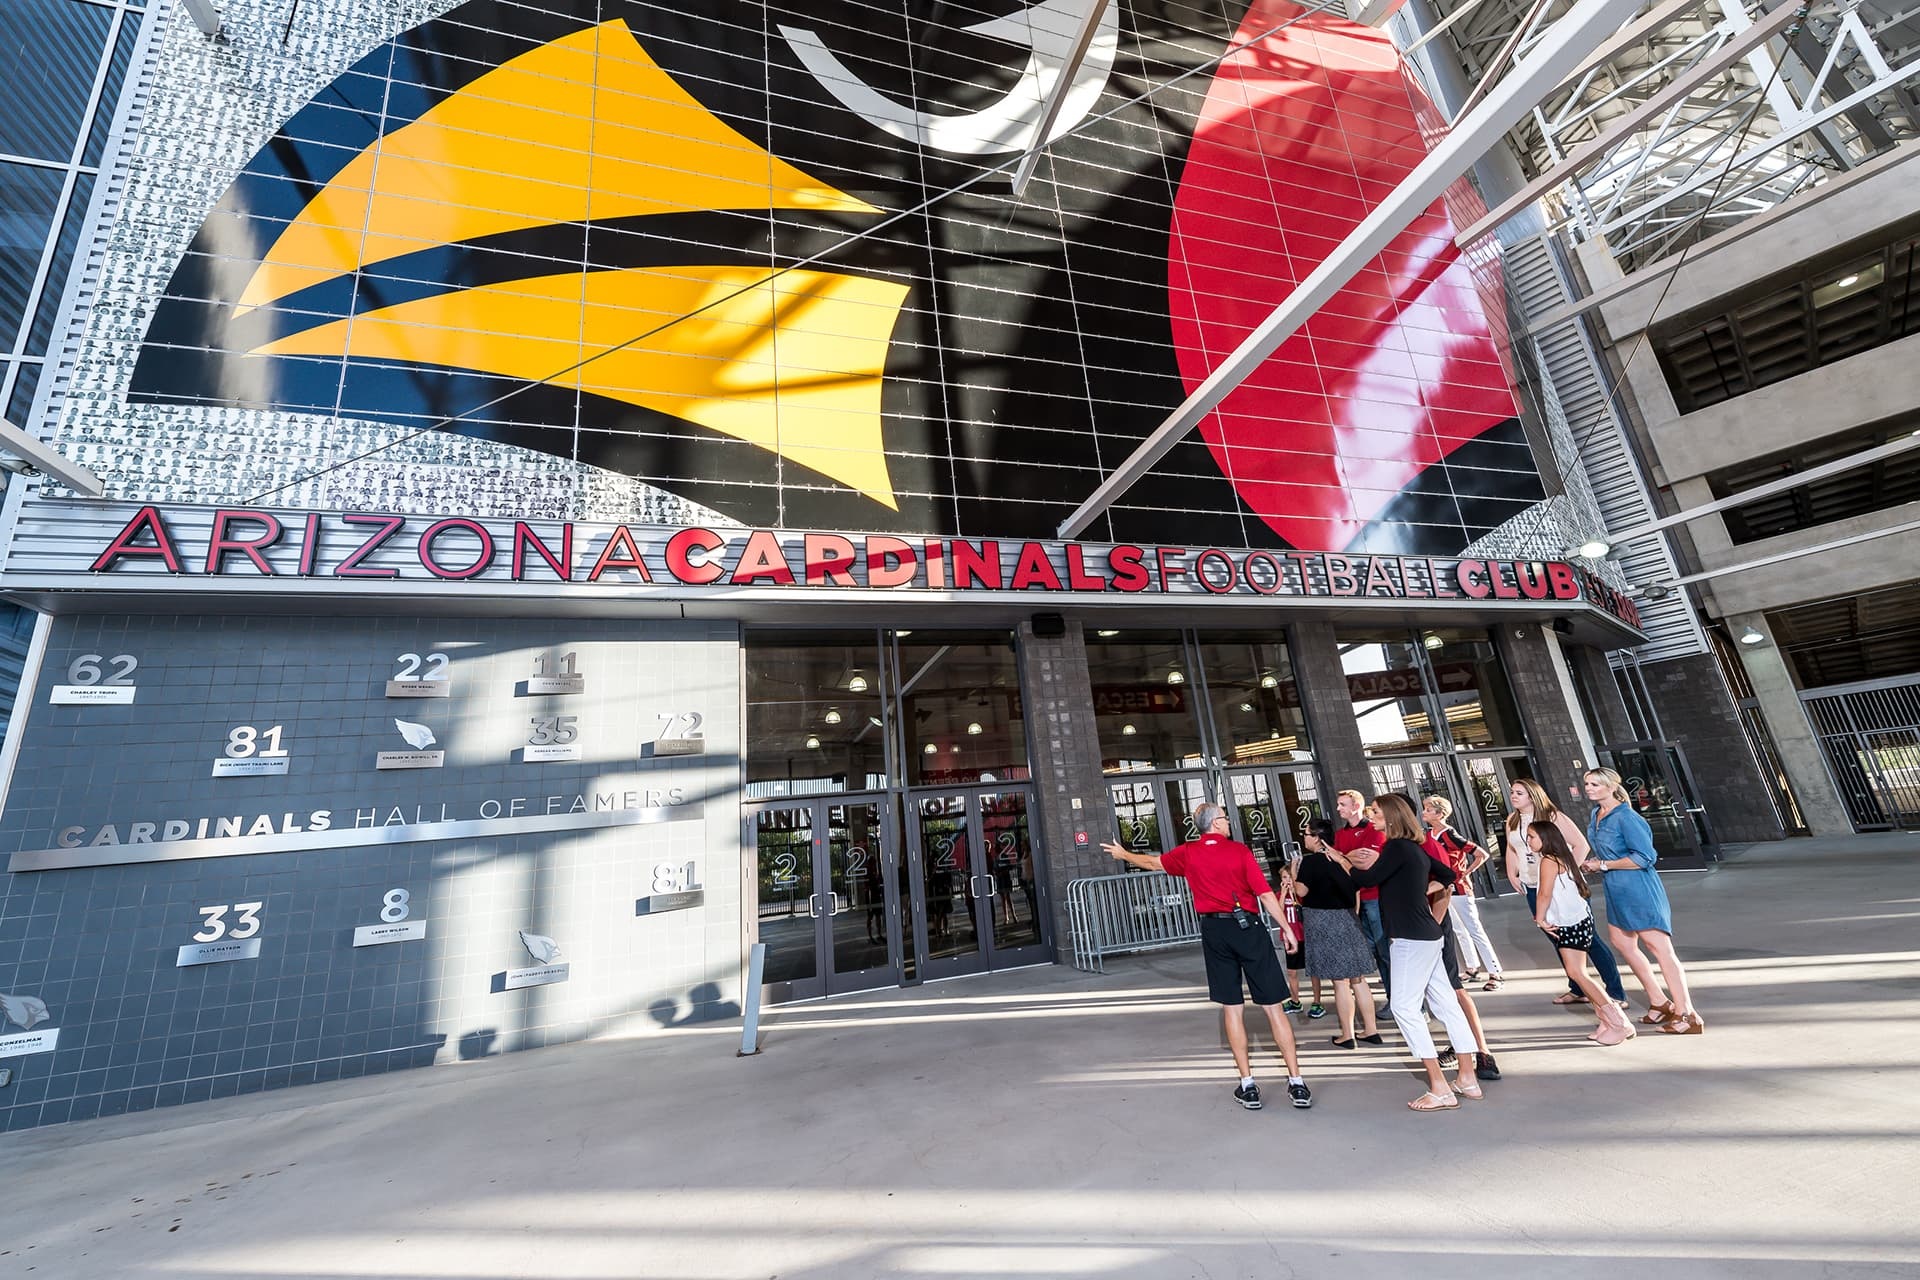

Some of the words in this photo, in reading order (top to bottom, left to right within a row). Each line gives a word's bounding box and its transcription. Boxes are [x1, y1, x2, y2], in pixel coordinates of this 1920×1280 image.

[88, 505, 654, 584] ARIZONA
[664, 527, 1150, 592] CARDINALS
[1155, 546, 1457, 598] FOOTBALL
[1456, 558, 1581, 600] CLUB
[67, 654, 138, 686] 62
[394, 653, 450, 681] 22
[532, 651, 583, 678] 11
[529, 715, 578, 745] 35
[657, 711, 703, 740] 72
[225, 725, 288, 758] 81
[1481, 790, 1498, 813] 2
[57, 810, 332, 848] CARDINALS
[354, 802, 457, 829] HALL
[479, 798, 527, 820] OF
[546, 787, 684, 814] FAMERS
[1183, 816, 1201, 841] 2
[1250, 810, 1267, 835] 2
[1297, 806, 1311, 830] 2
[999, 832, 1018, 860] 2
[1131, 820, 1150, 847] 2
[847, 847, 868, 877] 2
[936, 838, 956, 867] 2
[652, 861, 702, 893] 81
[774, 853, 798, 885] 2
[380, 889, 410, 923] 8
[1286, 906, 1296, 923] 11
[193, 901, 263, 943] 33
